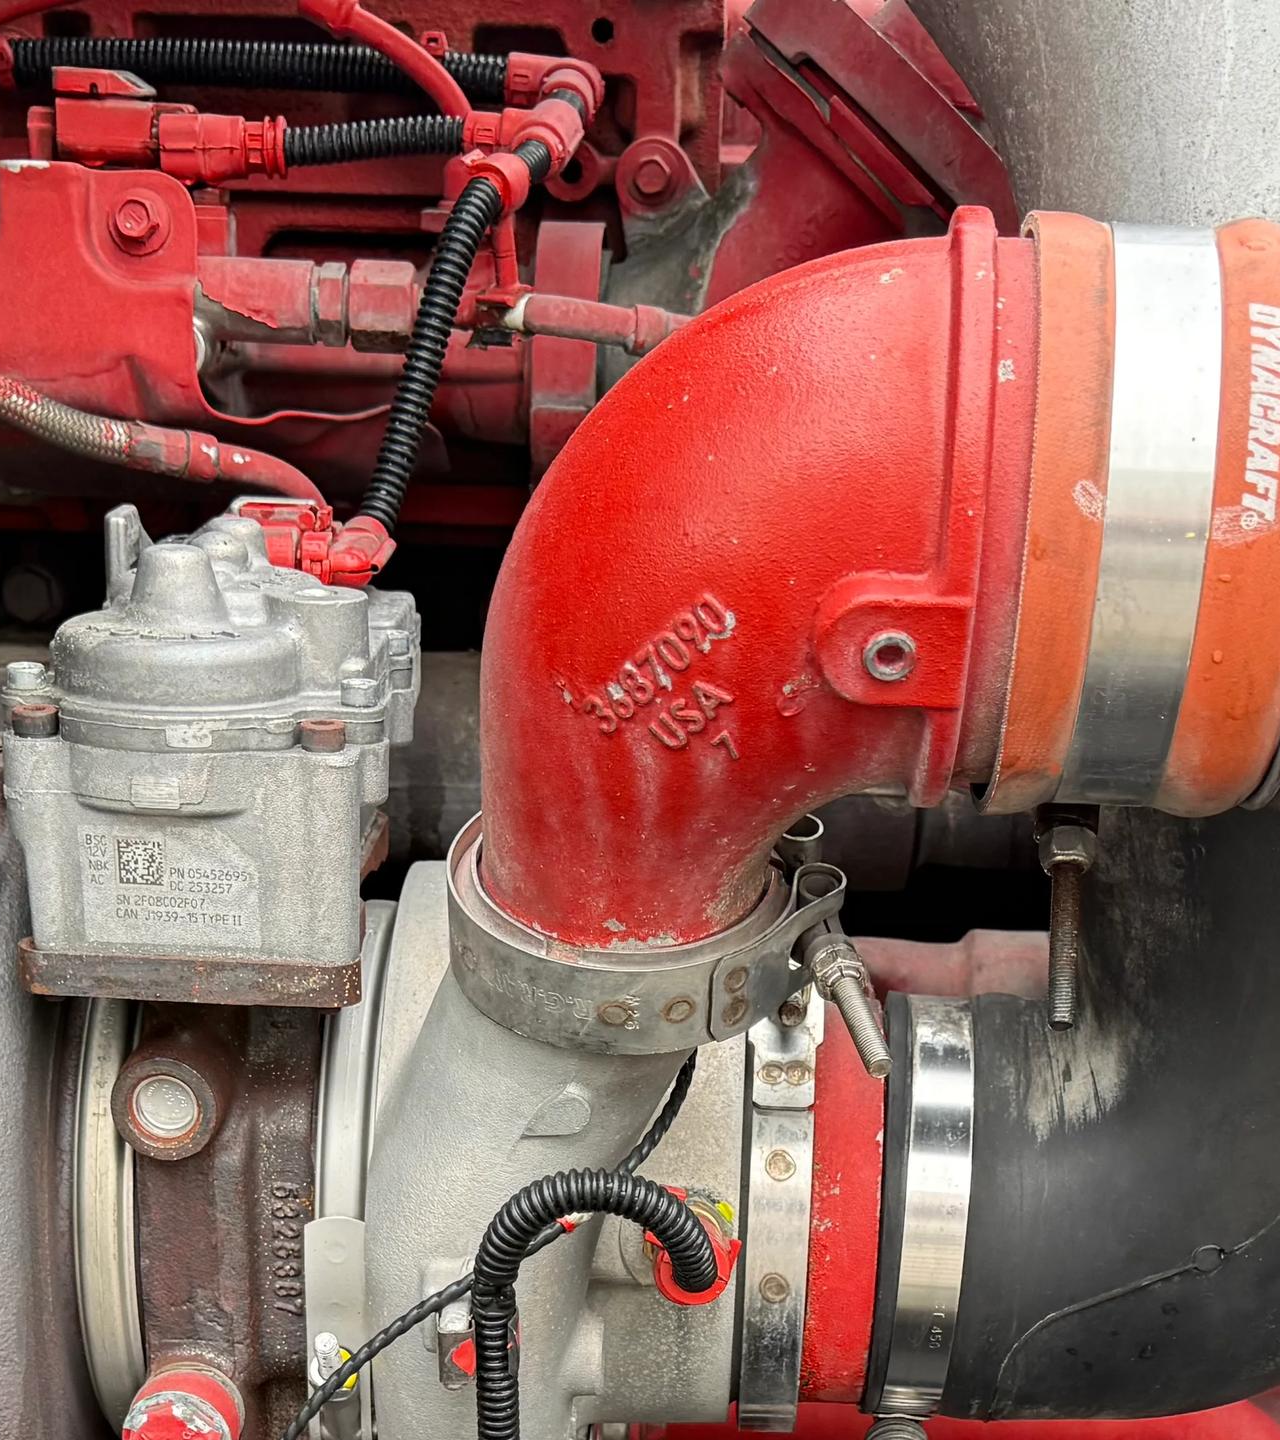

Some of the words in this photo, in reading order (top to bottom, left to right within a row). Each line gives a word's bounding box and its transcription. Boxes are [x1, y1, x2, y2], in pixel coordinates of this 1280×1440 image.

[649, 680, 735, 749] USA
[170, 868, 184, 879] PN
[116, 894, 130, 905] SN
[116, 908, 138, 919] CAN
